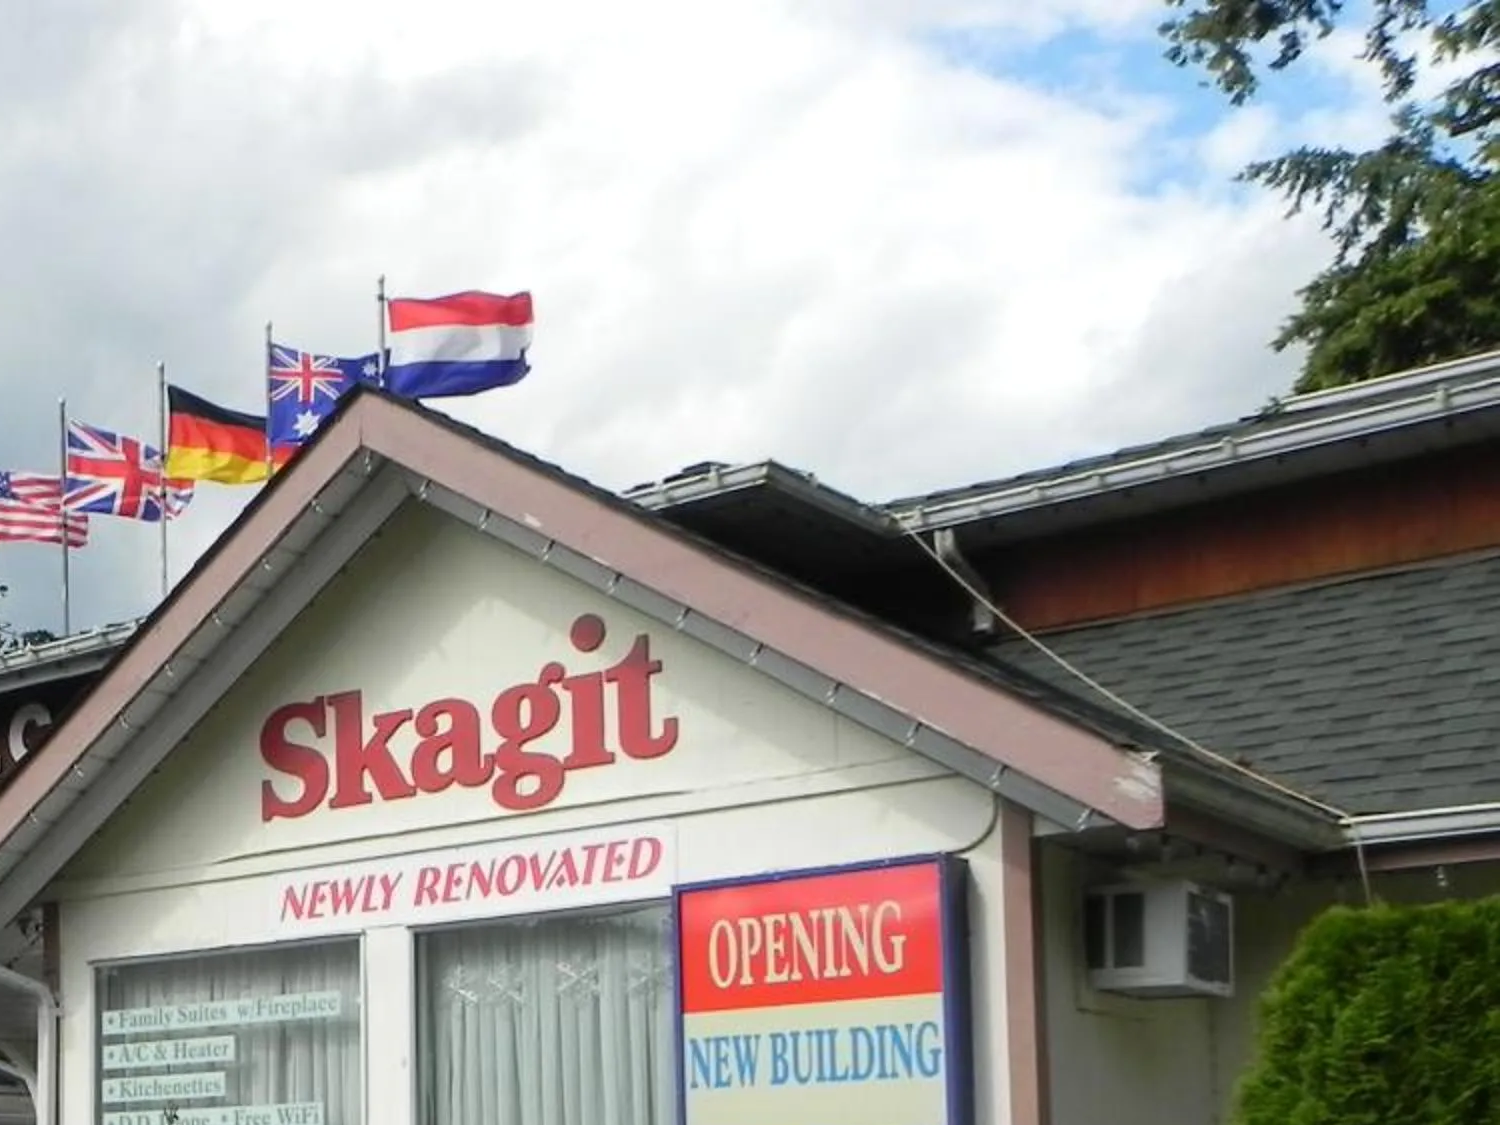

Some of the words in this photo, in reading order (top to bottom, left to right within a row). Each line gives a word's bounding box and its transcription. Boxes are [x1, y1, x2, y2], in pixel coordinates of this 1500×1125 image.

[259, 613, 679, 822] Skagit
[280, 870, 404, 923] NEWLY
[413, 836, 663, 907] RENOVATED
[708, 900, 907, 989] OPENING
[119, 1007, 174, 1028] Family
[177, 1004, 227, 1024] Suites
[256, 992, 338, 1017] Fireplace
[174, 1039, 229, 1059] Heater
[689, 1034, 761, 1089] NEW
[769, 1021, 943, 1086] BUILDING
[119, 1076, 223, 1098] Kitchenettes
